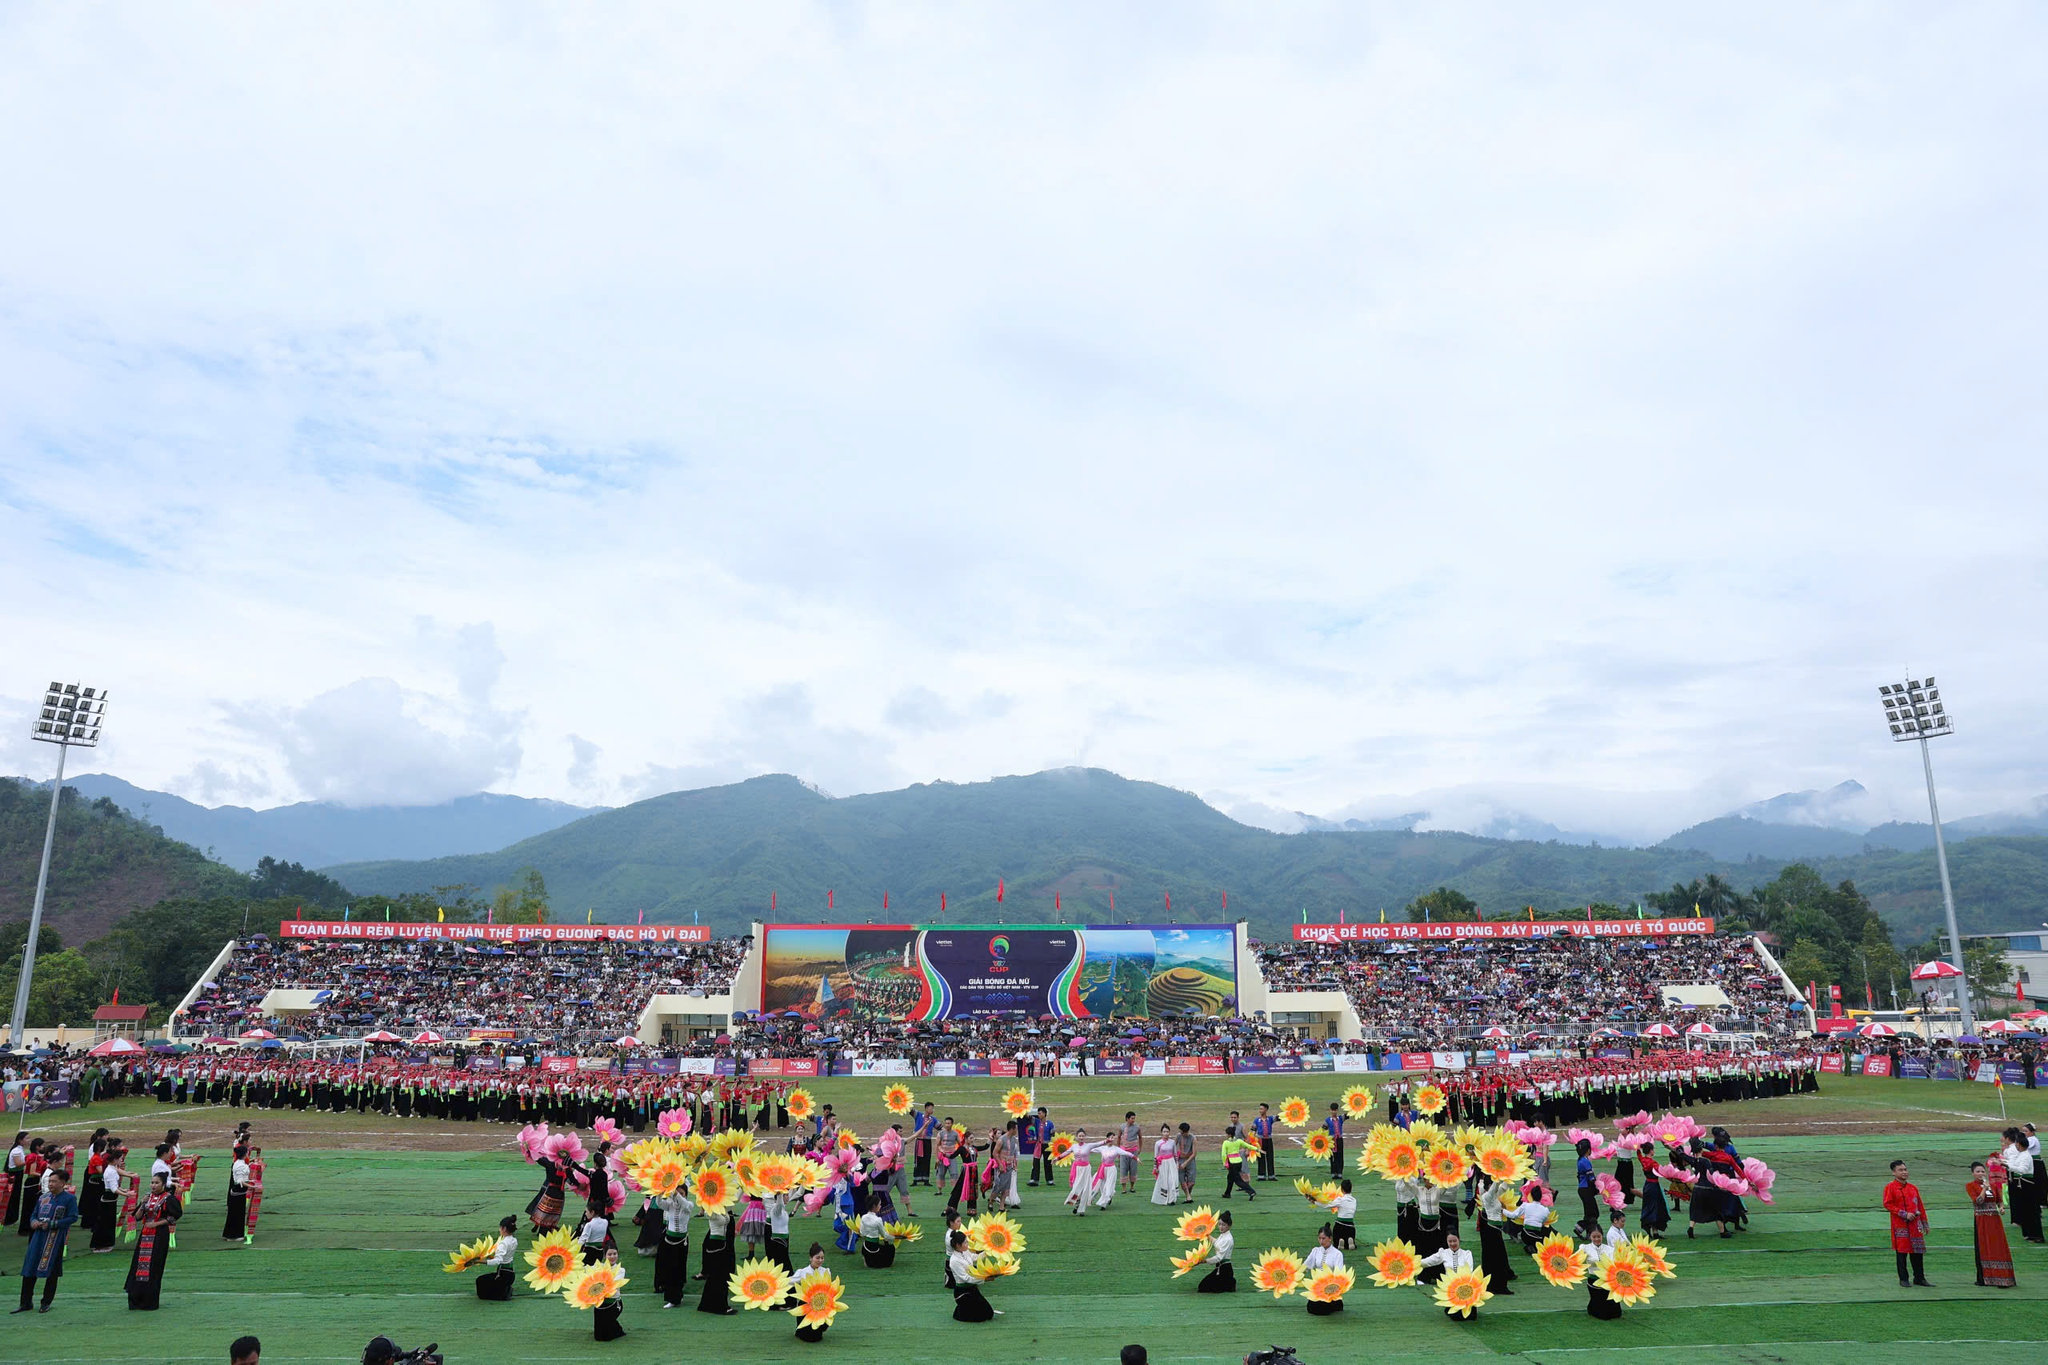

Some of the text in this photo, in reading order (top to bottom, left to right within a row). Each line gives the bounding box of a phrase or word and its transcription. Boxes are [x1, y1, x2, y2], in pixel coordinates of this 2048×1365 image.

[290, 922, 327, 936] TOÀN
[332, 923, 362, 936] DÂN
[366, 923, 394, 936] RÈN
[448, 925, 484, 938] THÂN
[518, 928, 552, 938] THEO
[556, 928, 604, 939] GƯƠNG
[608, 926, 634, 939] BÁC
[639, 926, 657, 940] HỒ
[662, 926, 675, 940] VĨ
[678, 930, 702, 942] ĐẠI
[1340, 924, 1358, 938] ĐỂ
[1362, 928, 1390, 939] HỌC
[1393, 925, 1422, 939] TẬP,
[1427, 926, 1452, 937] LAO
[1456, 924, 1497, 938] ĐỘNG,
[1502, 924, 1528, 936] XÂY
[1572, 922, 1590, 934] VÀ
[1594, 922, 1622, 934] BẢO
[1625, 922, 1642, 935] VỆ
[1646, 920, 1664, 933] TỔ
[1668, 920, 1706, 932] QUỐC
[1018, 976, 1030, 985] NỮ
[1868, 1062, 1879, 1072] 5G
